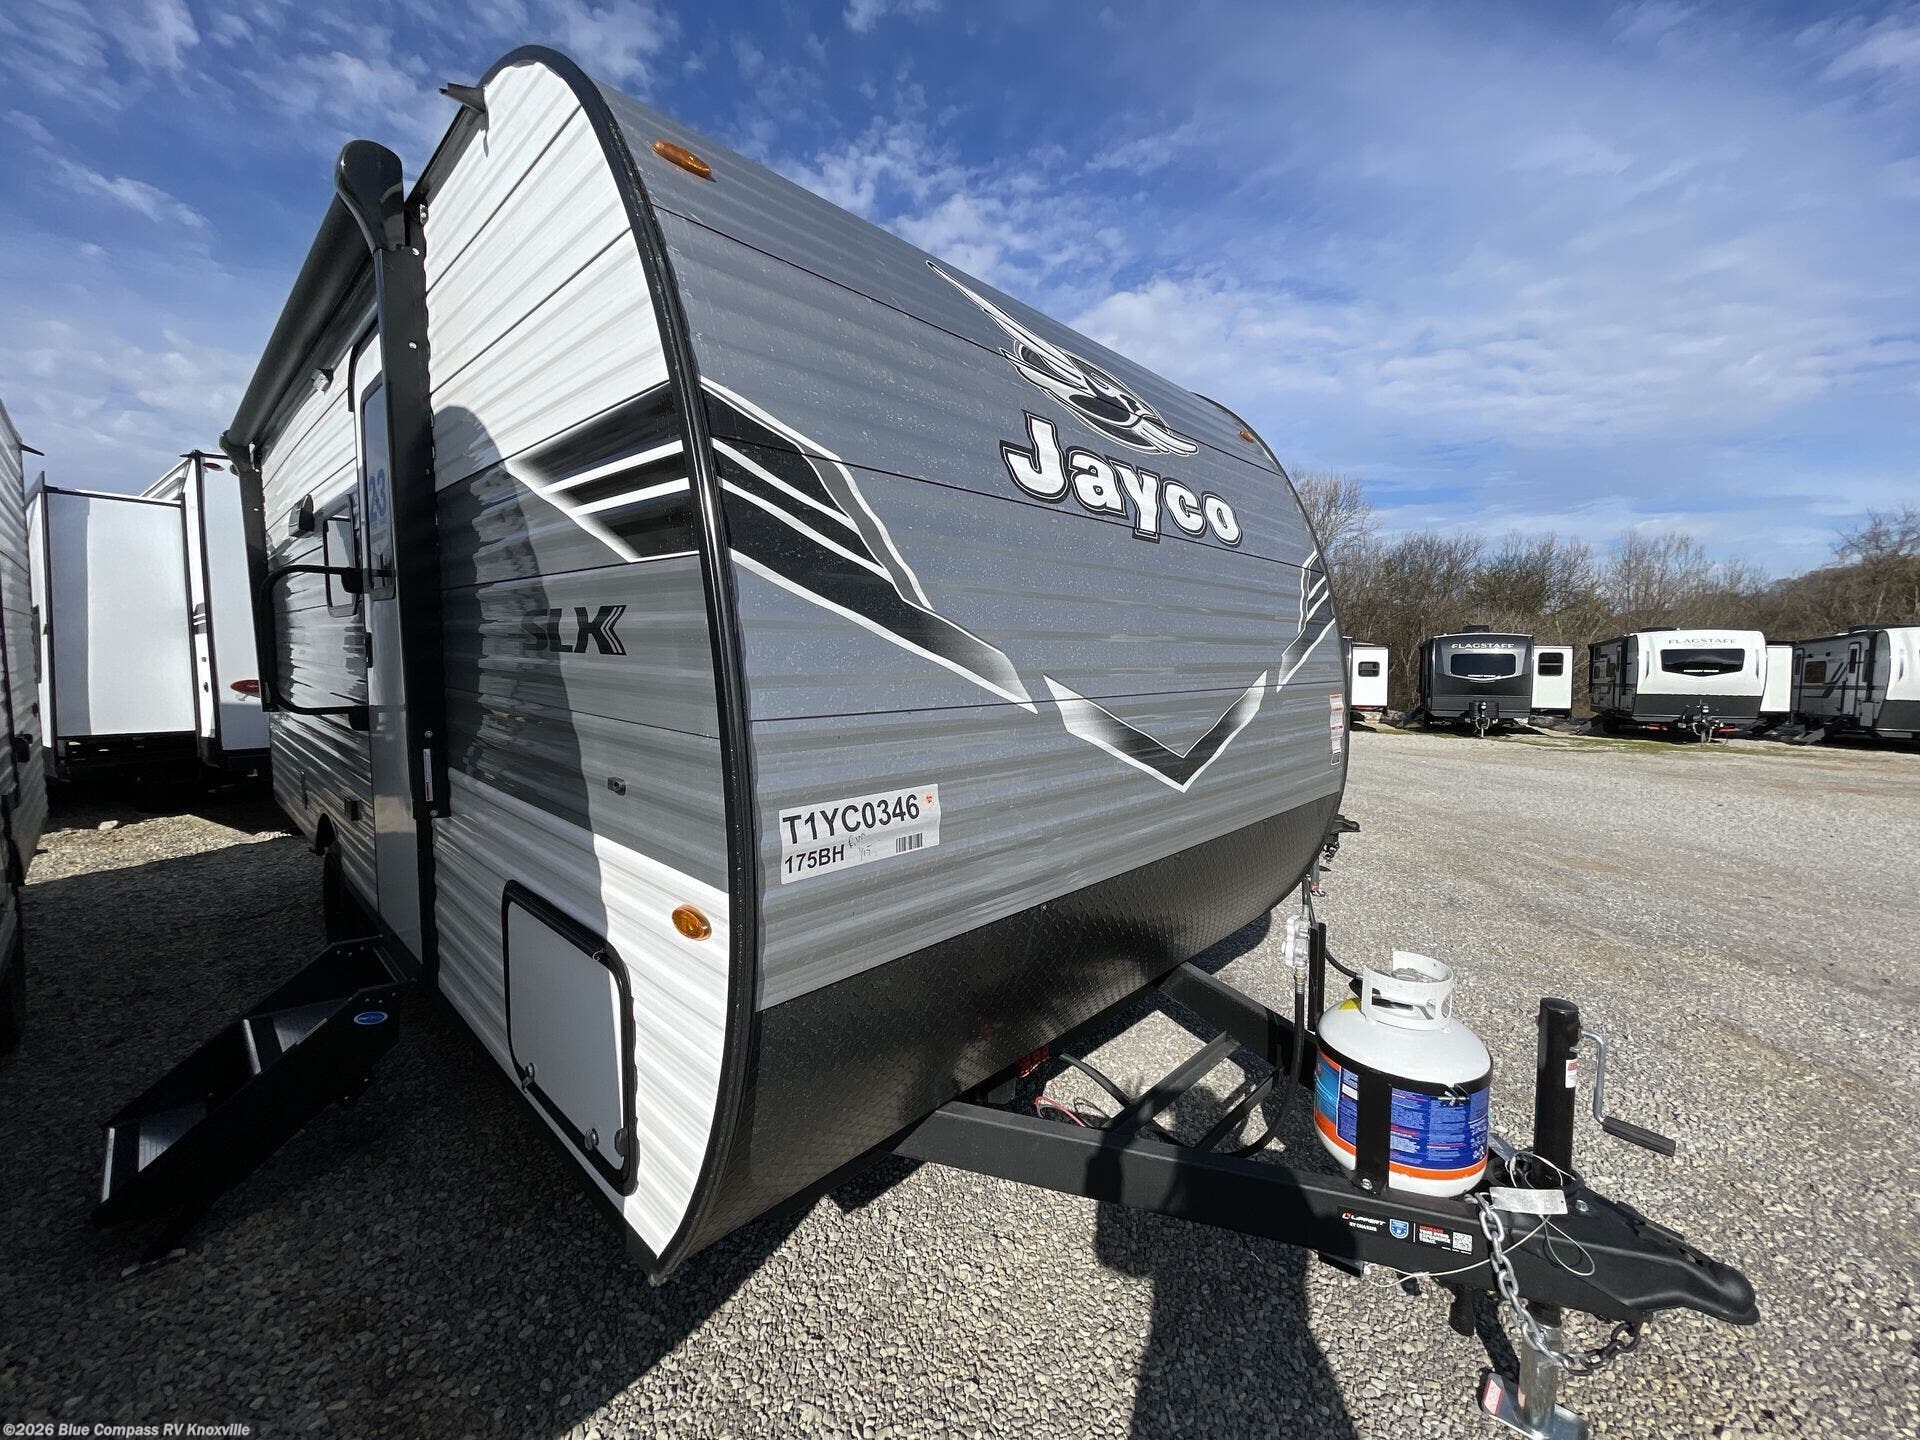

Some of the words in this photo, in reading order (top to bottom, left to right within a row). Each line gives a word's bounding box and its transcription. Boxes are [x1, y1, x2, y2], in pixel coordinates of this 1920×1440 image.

[1001, 410, 1242, 546] Jayco
[521, 604, 627, 656] SLK
[782, 794, 920, 845] T1YC0346
[784, 844, 845, 874] 175BH
